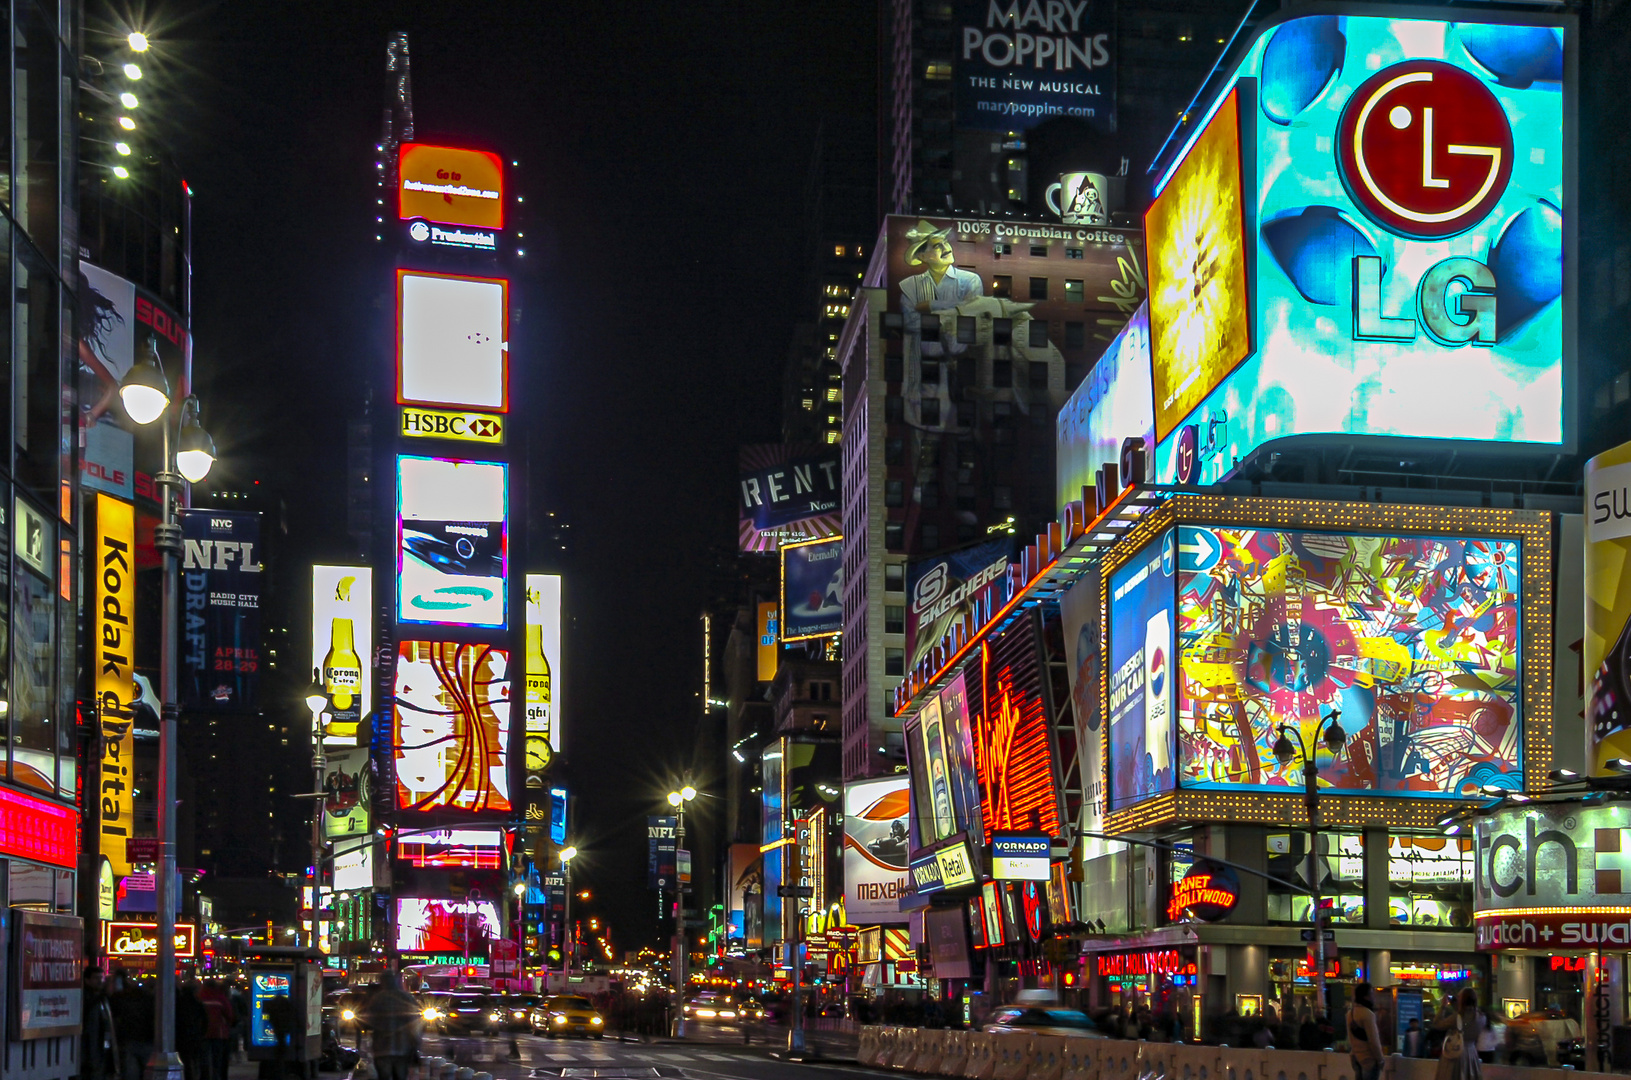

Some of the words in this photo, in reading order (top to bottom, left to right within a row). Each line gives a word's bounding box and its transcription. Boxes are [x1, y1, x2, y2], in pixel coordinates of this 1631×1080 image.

[987, 0, 1087, 32] MARY
[963, 27, 1109, 71] POPPINS
[970, 76, 996, 89] THE
[1003, 79, 1034, 91] NEW
[1039, 81, 1102, 95] MUSICAL
[977, 101, 1095, 117] marypoppins.com
[436, 168, 449, 180] Go
[451, 171, 461, 181] to
[957, 221, 991, 235] 100%
[995, 223, 1072, 240] Colombian
[1076, 230, 1125, 244] Coffee
[1353, 256, 1498, 347] LG
[403, 412, 466, 436] HSBC
[741, 461, 836, 508] RENT
[810, 501, 836, 511] Now
[211, 518, 233, 529] NYC
[183, 540, 262, 573] NFL
[210, 592, 236, 600] RADIO
[919, 555, 1008, 631] SKECHERS
[103, 535, 129, 678] Kodak
[186, 572, 207, 670] DRAFT
[215, 648, 259, 660] APRIL
[326, 667, 359, 680] Corona
[1110, 681, 1127, 712] OUR
[1127, 666, 1144, 696] CAN
[648, 827, 676, 838] NFL
[995, 842, 1047, 851] VORNADO
[912, 861, 941, 887] VORNADO
[941, 851, 967, 880] Retail
[545, 877, 565, 886] NFL
[857, 878, 905, 900] maxell
[1174, 875, 1212, 896] LANET
[1476, 918, 1537, 945] swatch
[1561, 922, 1631, 944] swa
[114, 935, 187, 953] Chapene
[1098, 954, 1124, 976] PLANET
[1126, 950, 1179, 975] HOLLYWOOD
[1551, 955, 1607, 971] PLA
